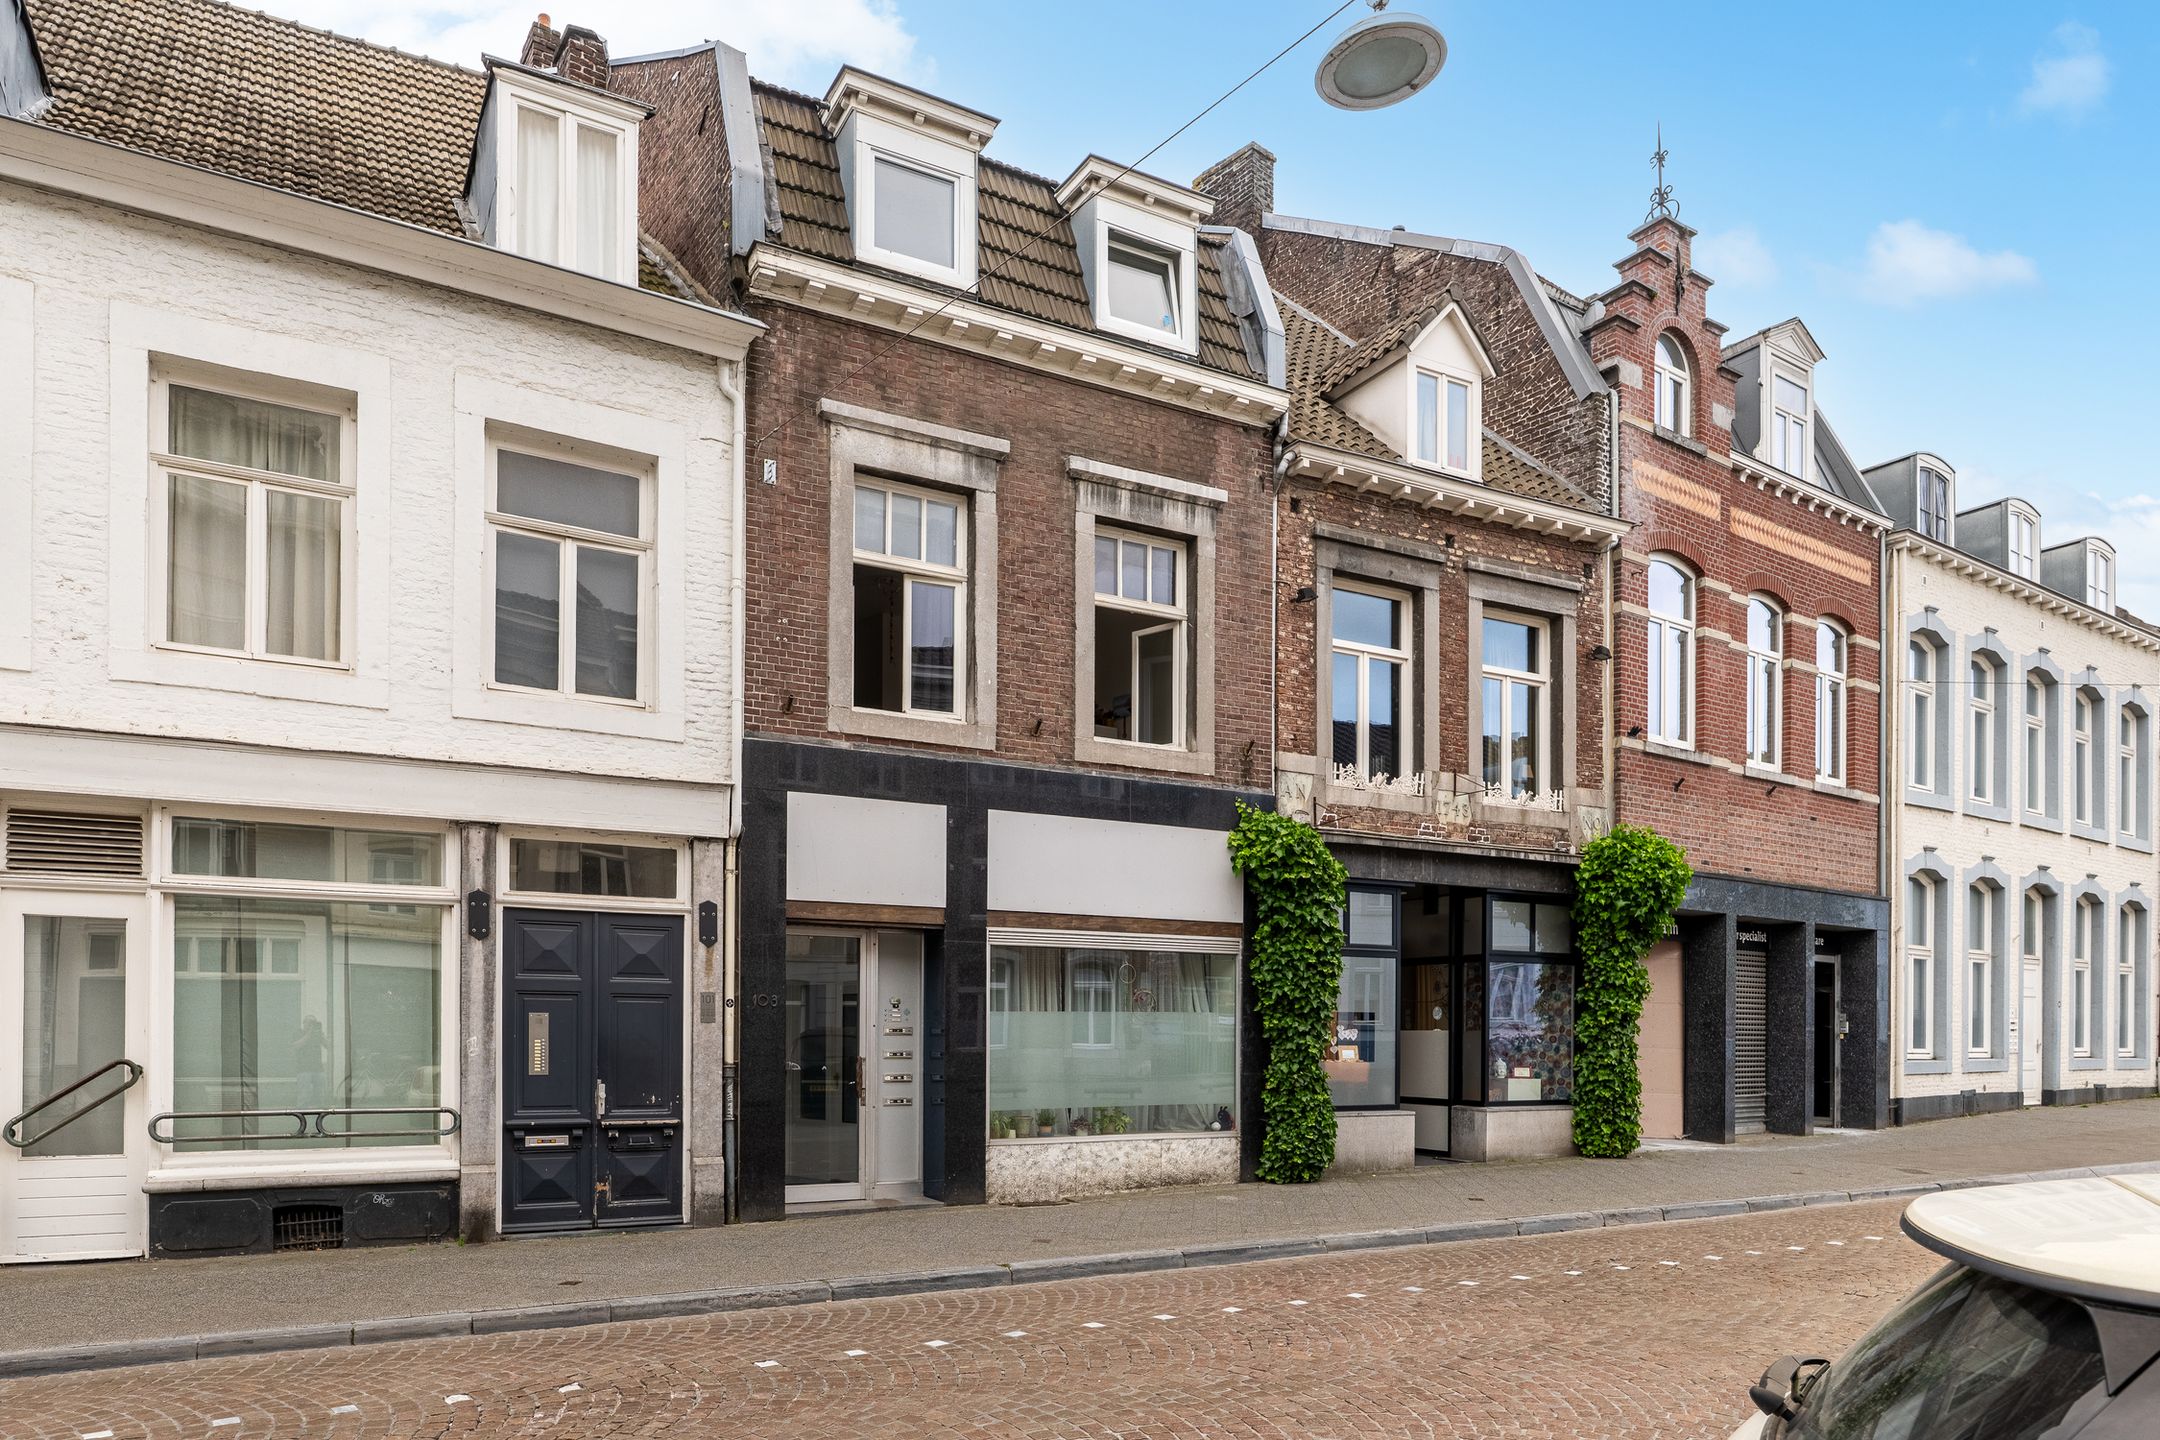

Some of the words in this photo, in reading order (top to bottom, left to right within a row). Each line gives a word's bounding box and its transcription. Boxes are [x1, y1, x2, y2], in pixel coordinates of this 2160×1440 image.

[1739, 931, 1767, 943] specialist
[701, 994, 715, 1004] 101
[752, 993, 778, 1008] 103
